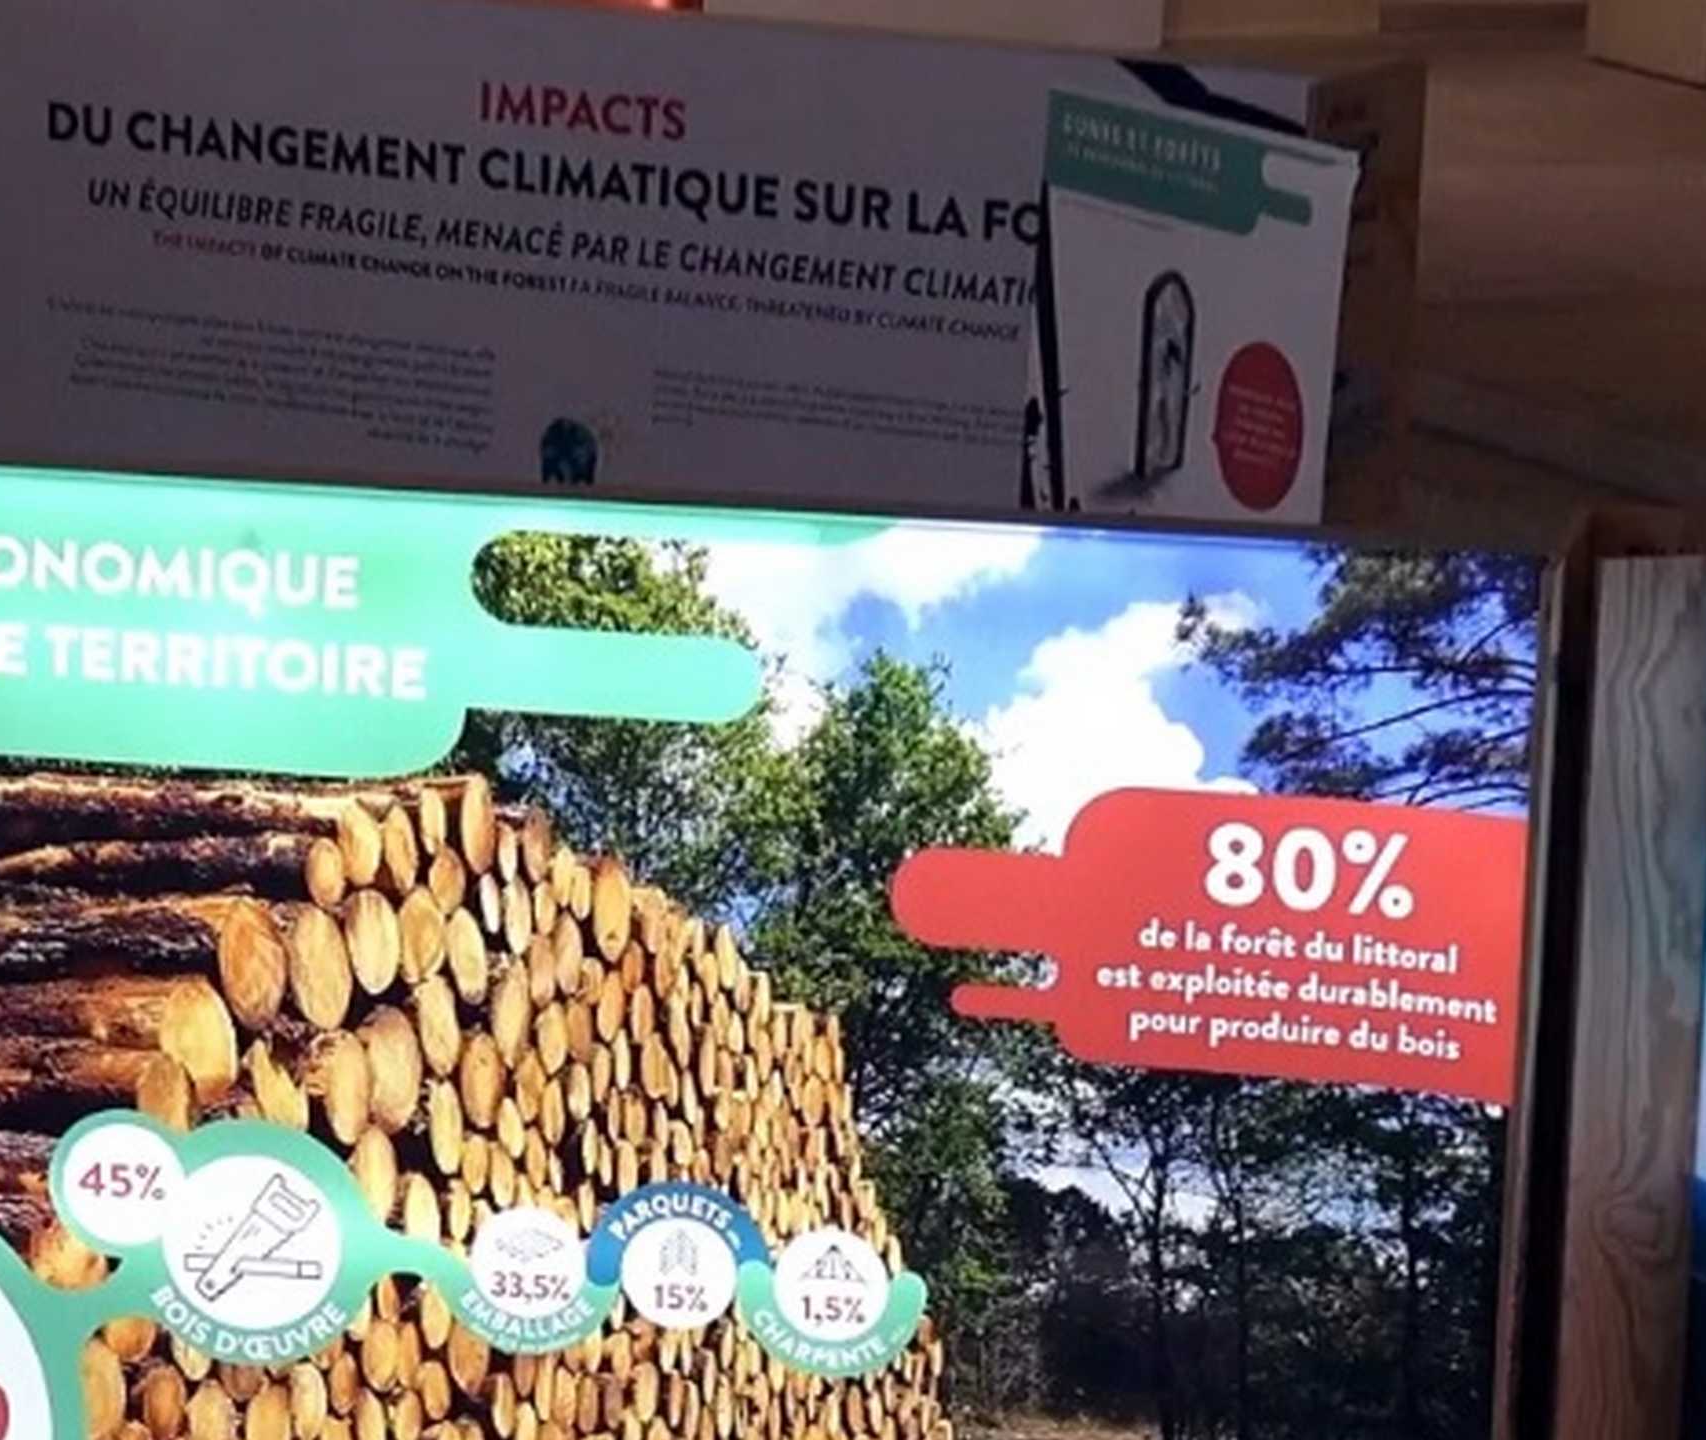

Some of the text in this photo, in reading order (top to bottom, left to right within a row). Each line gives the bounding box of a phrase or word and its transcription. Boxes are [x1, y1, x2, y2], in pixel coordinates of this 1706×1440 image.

[480, 82, 687, 141] IMPACTS
[48, 102, 1043, 246] DU CHANGEMENT CLIMATIQUE SUR LA FO
[88, 178, 131, 209] UN
[138, 178, 292, 229] ÉQUILIBRE
[300, 201, 428, 249] FRAGILE,
[436, 214, 565, 260] MENACÉ
[572, 232, 629, 267] PAR
[637, 241, 671, 270] LE
[680, 243, 897, 294] CHANGEMENT
[260, 243, 284, 262] OF
[287, 246, 356, 270] CLIMATE
[360, 252, 432, 278] CHANGE
[436, 263, 464, 282] ON
[466, 266, 498, 286] THE
[502, 270, 566, 294] FOREST
[45, 626, 430, 701] TERRITOIRE
[1205, 821, 1415, 920] 80%
[1139, 918, 1458, 975] de la forêt du littoral
[1096, 964, 1498, 1026] est exploitée durablement
[1129, 1012, 1461, 1061] pour produire du bois
[78, 1162, 166, 1201] 45%
[490, 1271, 571, 1304] 33,5%
[653, 1284, 709, 1312] 15%
[801, 1296, 866, 1325] 1,5%
[149, 1285, 349, 1360] BOIS D'ŒUVRE
